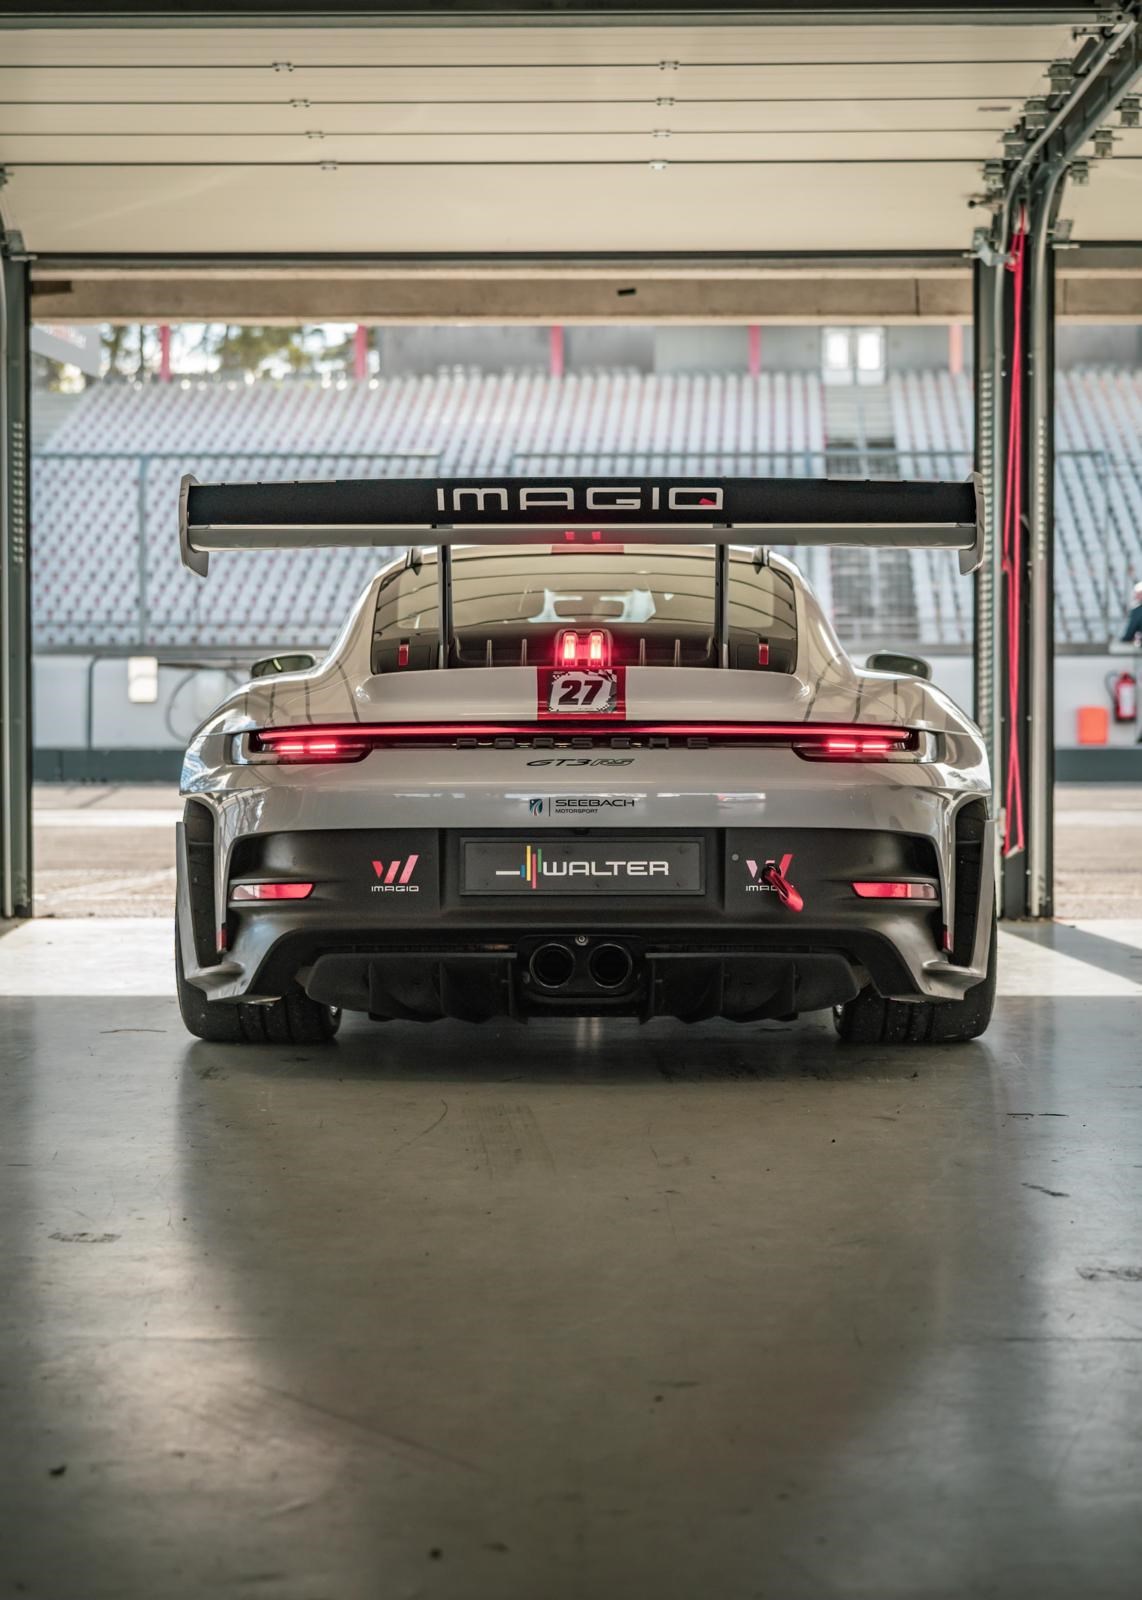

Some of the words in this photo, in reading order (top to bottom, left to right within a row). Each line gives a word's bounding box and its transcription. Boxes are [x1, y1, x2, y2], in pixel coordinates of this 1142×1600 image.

[558, 680, 604, 705] 27
[555, 799, 635, 807] SEEBACH
[542, 861, 669, 876] WALTER
